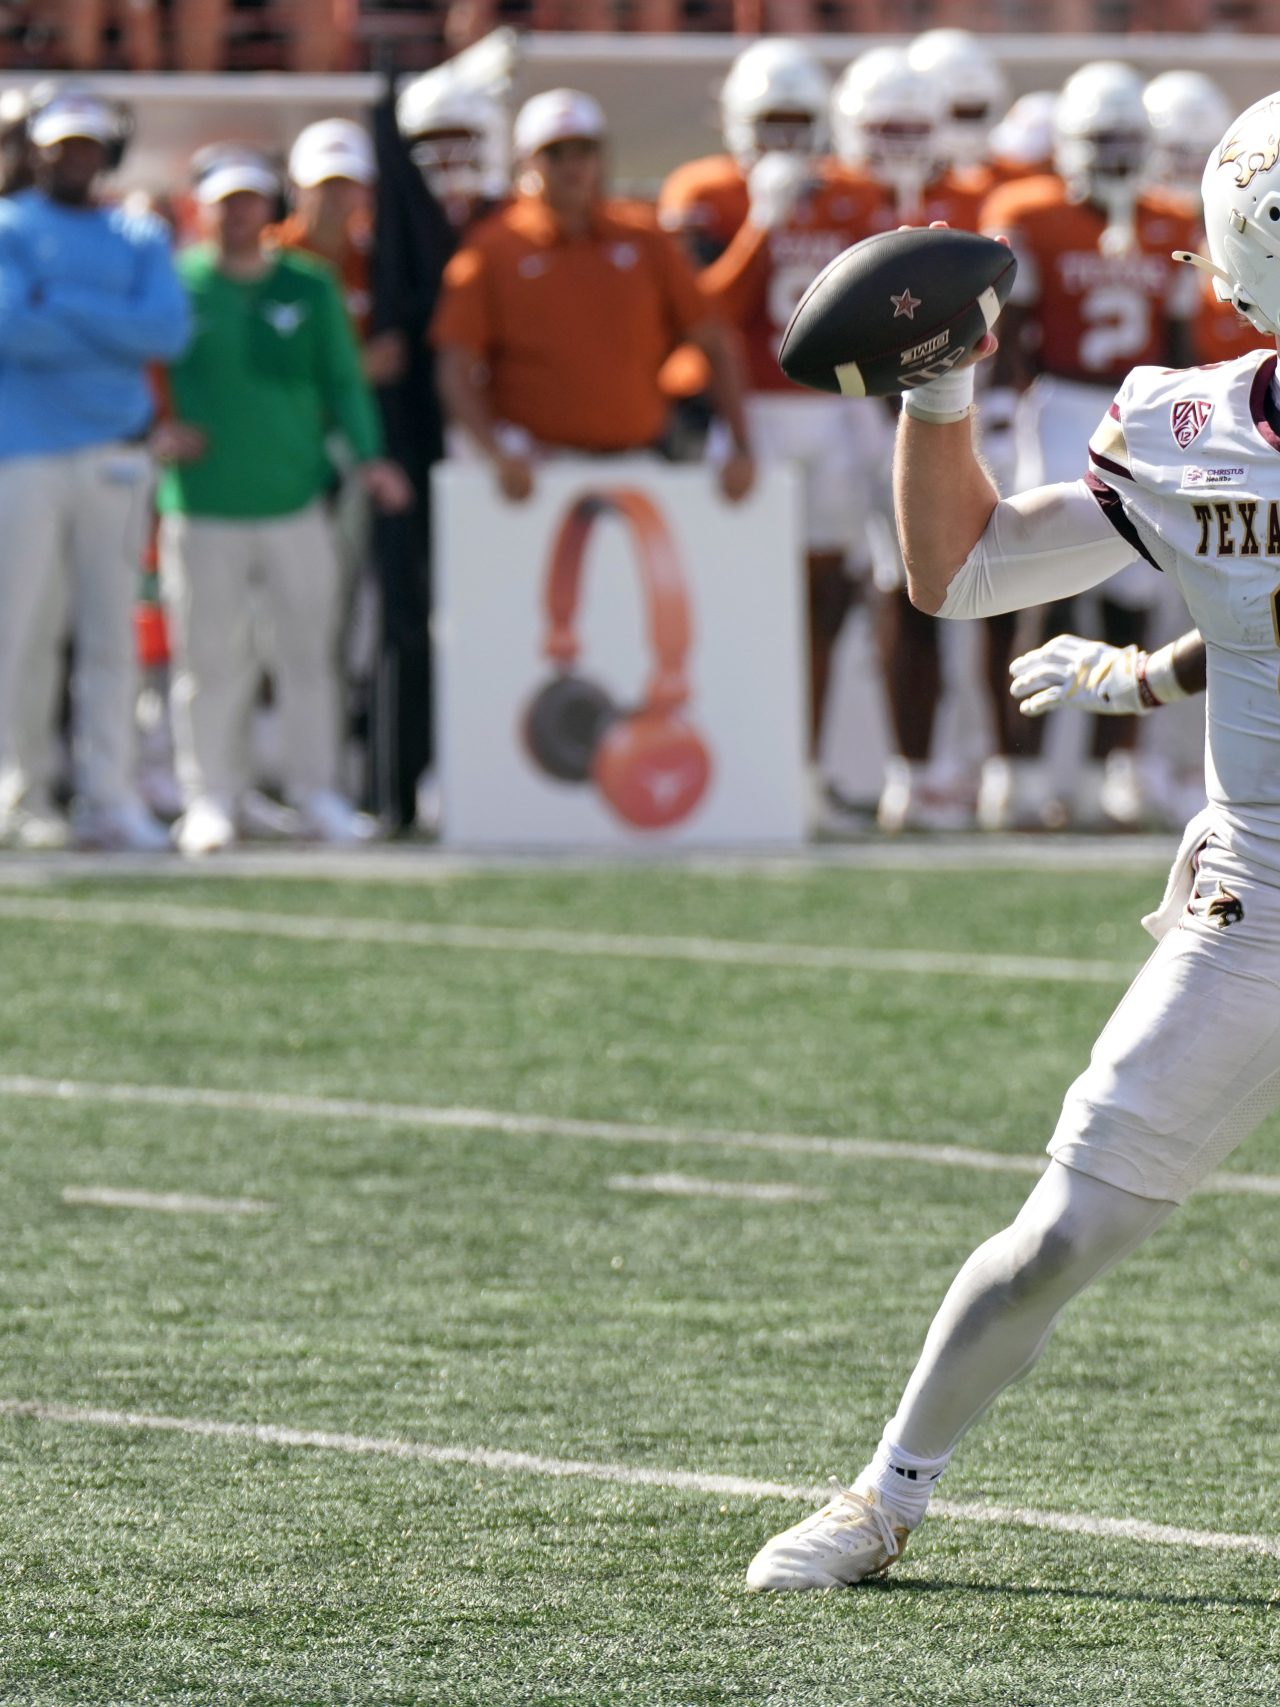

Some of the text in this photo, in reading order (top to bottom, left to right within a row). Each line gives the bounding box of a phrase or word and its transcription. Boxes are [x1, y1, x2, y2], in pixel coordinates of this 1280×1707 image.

[1172, 400, 1212, 430] PAC
[1180, 431, 1191, 441] 12
[1206, 468, 1244, 476] CHRISTUS
